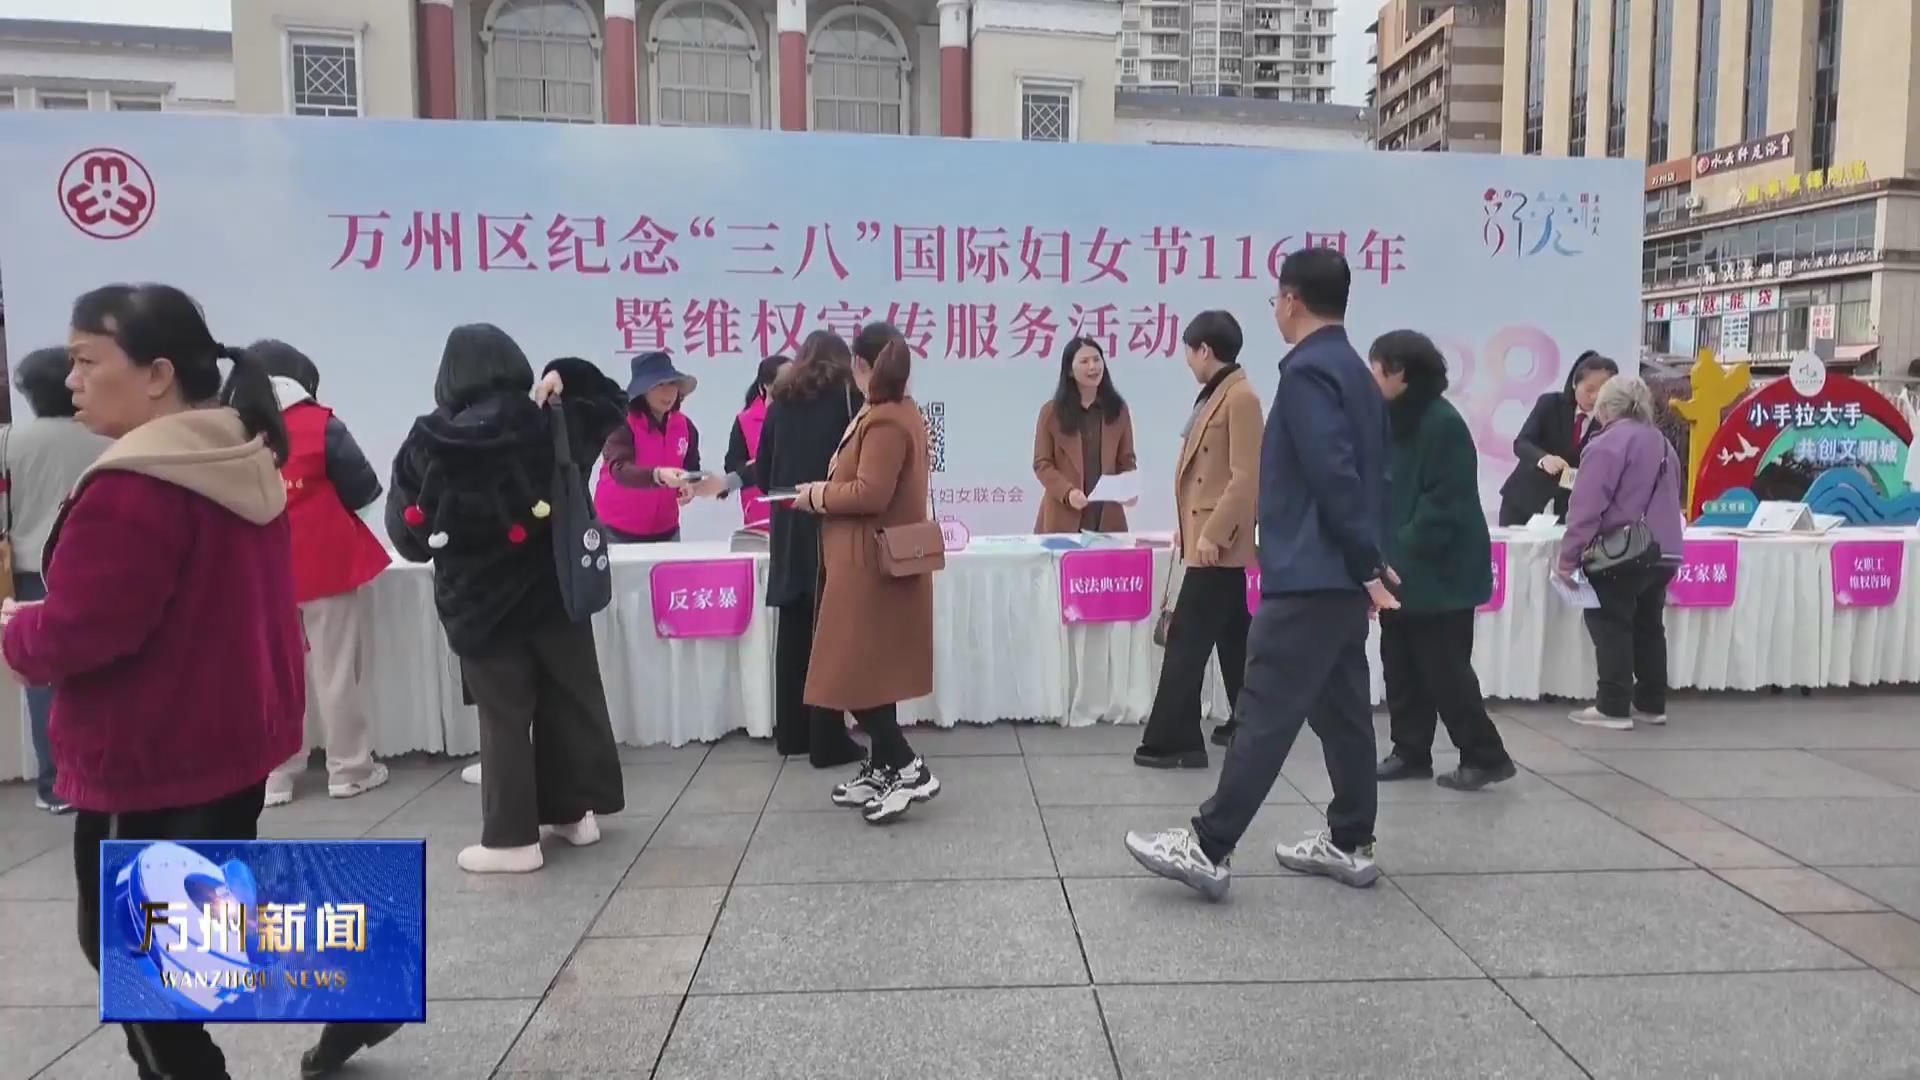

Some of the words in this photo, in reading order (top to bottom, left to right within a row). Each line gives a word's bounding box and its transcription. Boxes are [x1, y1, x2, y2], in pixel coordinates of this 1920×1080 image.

[1653, 289, 1772, 319] 有车就能贷
[614, 297, 1179, 359] 暨维权宣传服务活动
[1750, 400, 1863, 428] 小手拉大手
[1796, 438, 1899, 464] 共创文明城
[929, 486, 1024, 504] 妇女联合会
[1676, 562, 1728, 584] 反家暴
[1853, 557, 1885, 572] 女职工
[1069, 575, 1144, 595] 民法典宣传
[669, 586, 737, 610] 反家暴
